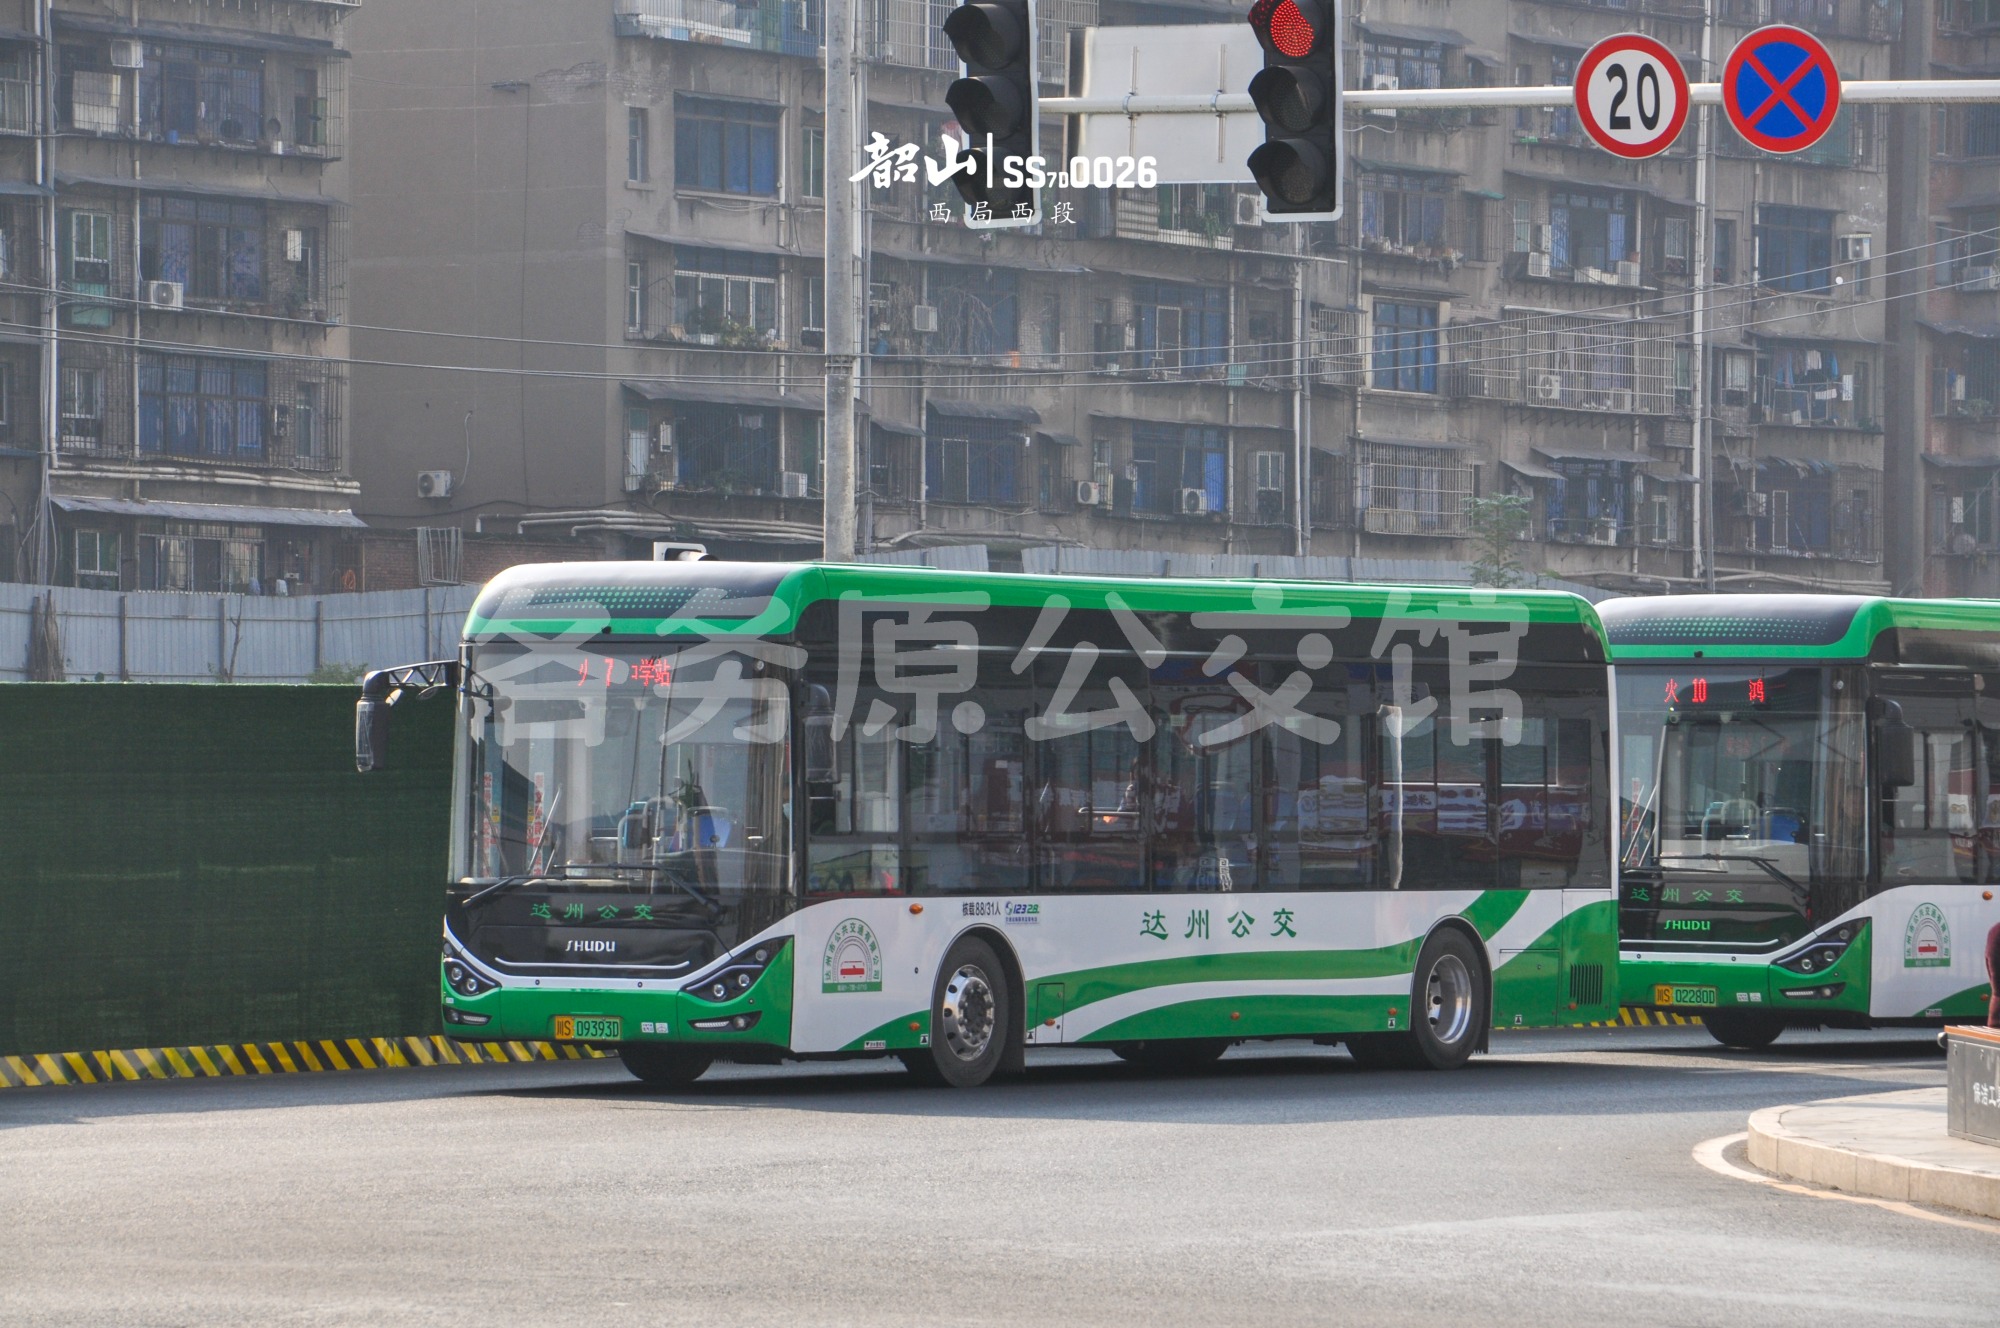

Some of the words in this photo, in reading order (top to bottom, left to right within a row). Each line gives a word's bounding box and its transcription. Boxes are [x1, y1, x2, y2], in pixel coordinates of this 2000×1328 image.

[1606, 63, 1660, 130] 20
[1692, 678, 1707, 702] 10
[1630, 888, 1744, 903] 达州公交
[530, 903, 654, 920] 达州公交
[1140, 908, 1297, 940] 达州公交
[1664, 920, 1711, 931] SHUDU
[565, 940, 616, 952] SHUDU
